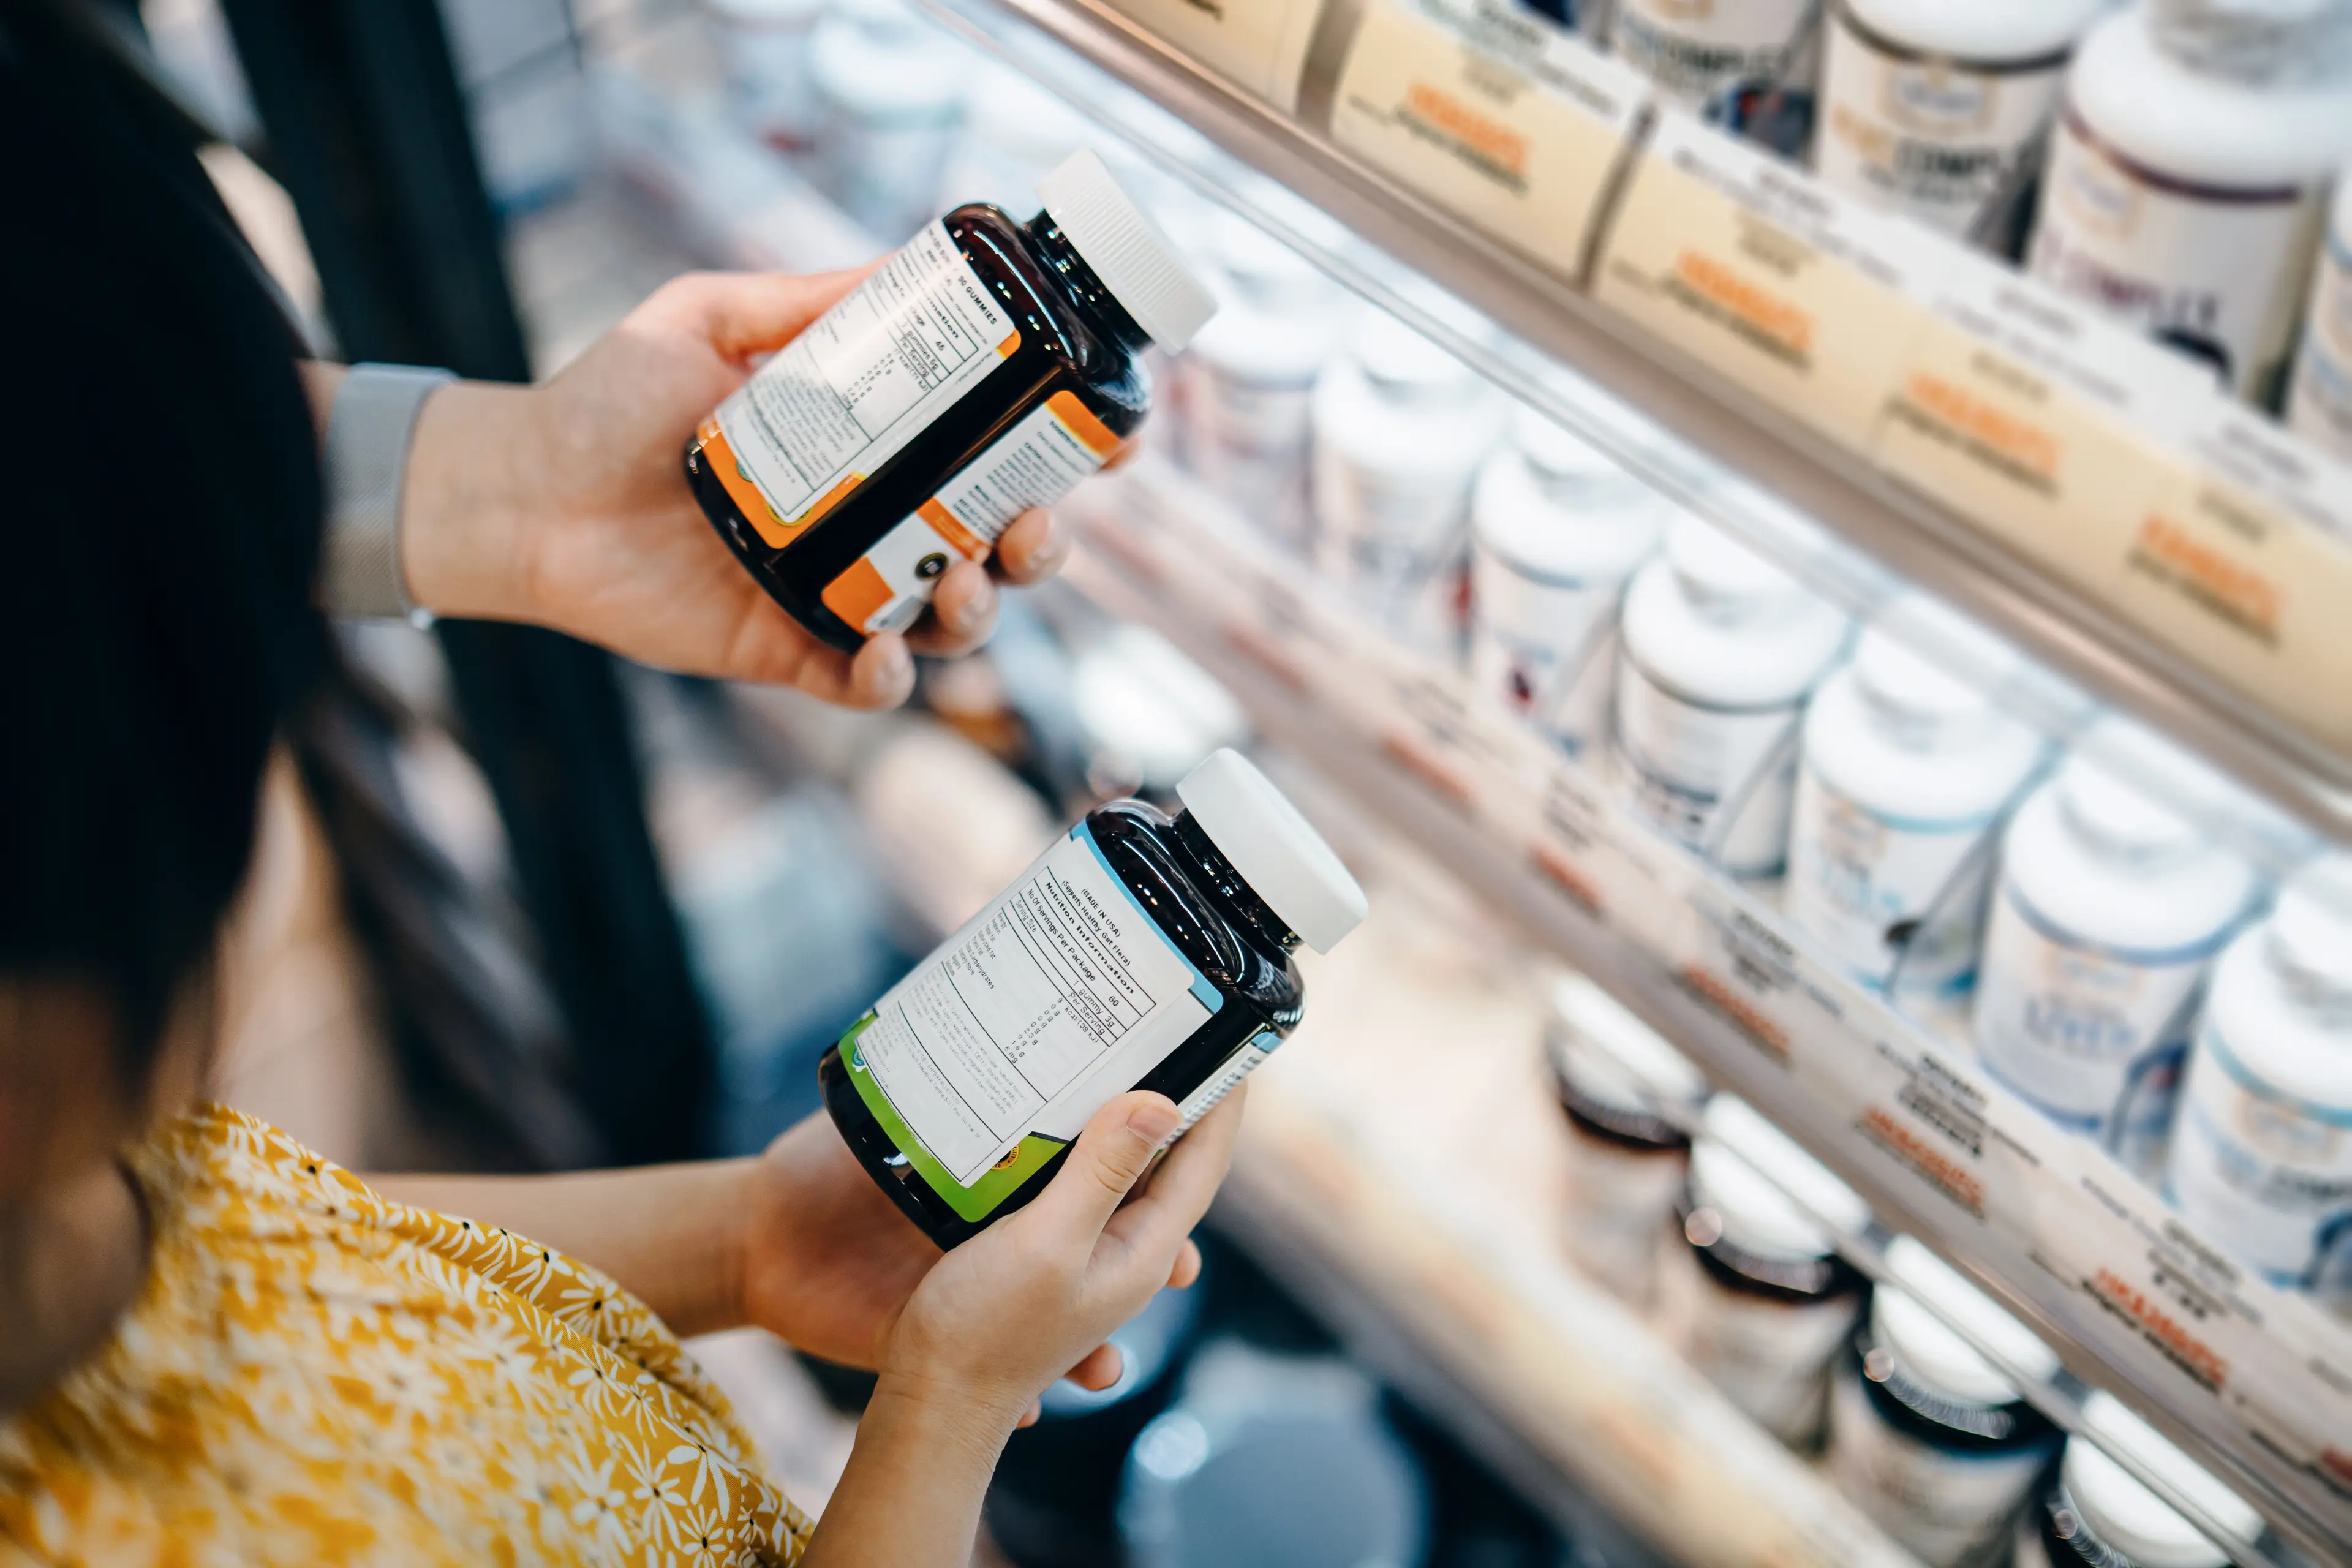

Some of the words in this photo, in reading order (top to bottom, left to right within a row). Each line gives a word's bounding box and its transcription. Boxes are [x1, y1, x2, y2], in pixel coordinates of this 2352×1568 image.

[967, 287, 997, 325] GUMMIES
[900, 335, 913, 349] Per
[910, 349, 930, 379] Serving
[906, 331, 931, 361] gummies
[1062, 881, 1081, 907] (Supports
[1081, 907, 1102, 932] Healthy
[1102, 932, 1114, 946] Gut
[1112, 945, 1131, 967] Flora)
[1082, 889, 1099, 910] (MADE
[1098, 910, 1107, 919] IN
[1106, 919, 1121, 938] USA)
[1028, 889, 1035, 899] No
[1032, 897, 1041, 907] Of
[1038, 905, 1058, 935] Servings
[1057, 933, 1069, 948] Per
[1068, 948, 1096, 981] Package
[1109, 996, 1120, 1007] 60
[1047, 883, 1075, 924] Nutrition
[1077, 926, 1134, 993] Information
[965, 952, 995, 989] Carbohydrates
[966, 962, 975, 976] fibre
[996, 913, 1008, 929] Energy
[1088, 1030, 1099, 1044] kJ)
[1014, 900, 1030, 922] Serving
[1027, 919, 1037, 933] Size
[1079, 986, 1104, 1017] gummy
[1104, 1016, 1115, 1030] 3g
[1068, 990, 1084, 1006] Per
[1081, 1005, 1106, 1038] Serving
[1006, 1052, 1019, 1065] mg
